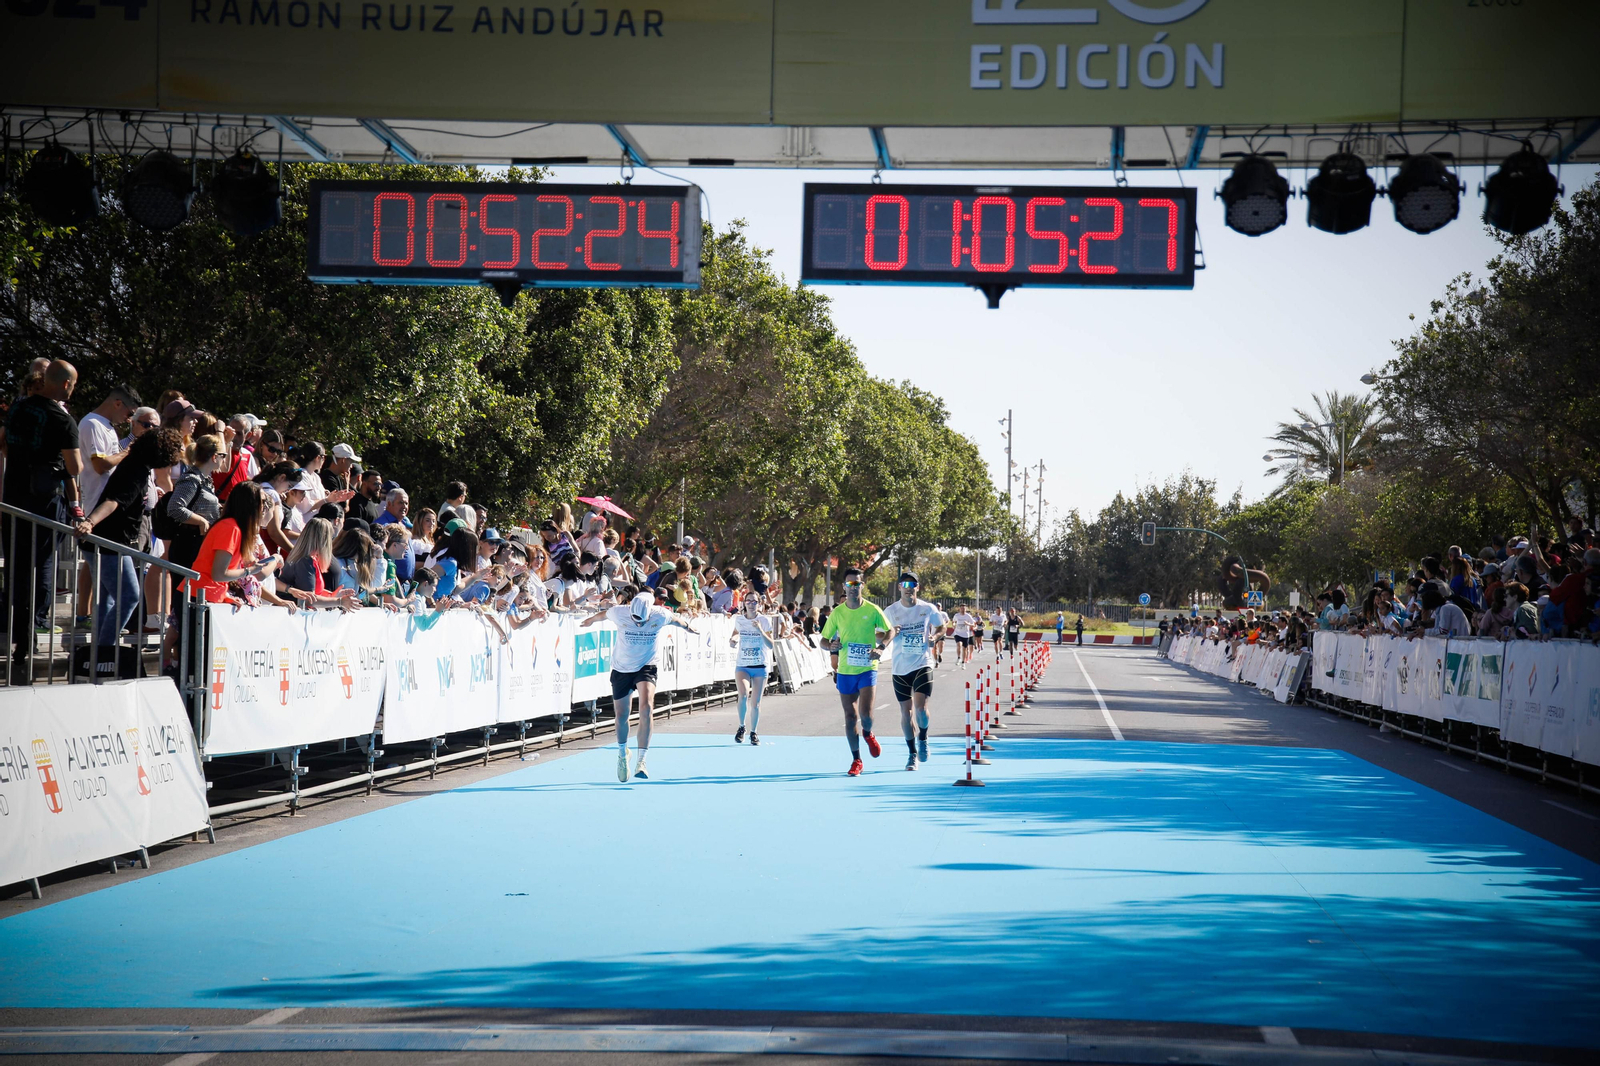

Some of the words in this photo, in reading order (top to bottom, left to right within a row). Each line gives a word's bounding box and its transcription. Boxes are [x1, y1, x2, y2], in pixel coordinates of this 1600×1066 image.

[361, 3, 454, 33] RUIZ
[471, 1, 665, 37] ANDÚJAR
[970, 31, 1224, 89] EDICIÓN
[864, 194, 1178, 274] 01:05:27
[904, 635, 924, 644] 5731
[65, 725, 129, 772] ALMERÍA
